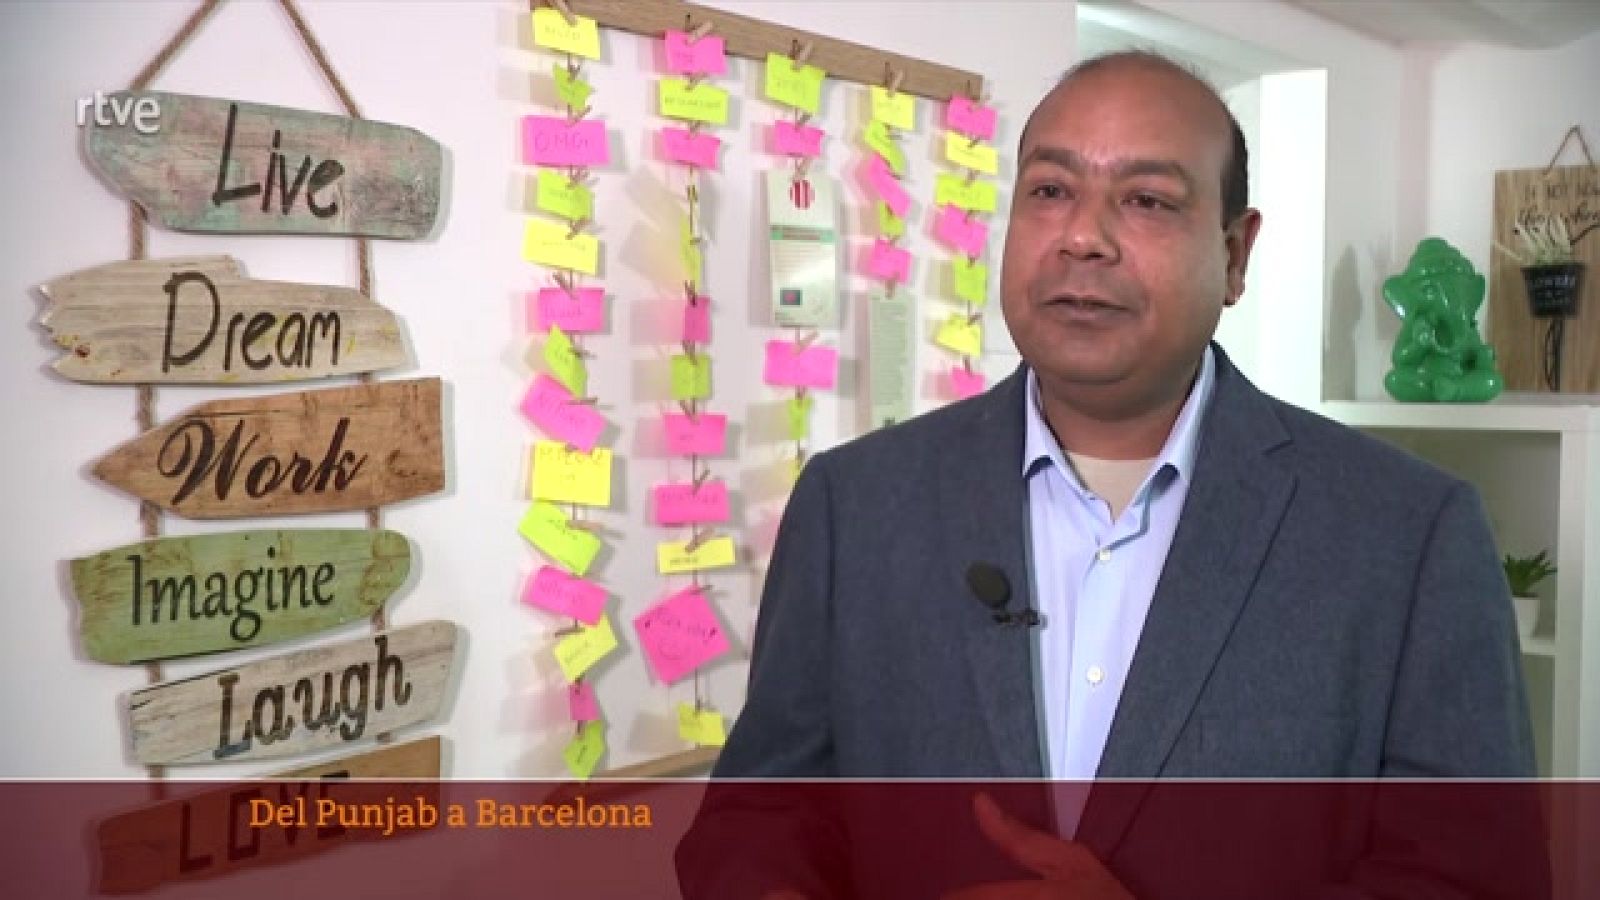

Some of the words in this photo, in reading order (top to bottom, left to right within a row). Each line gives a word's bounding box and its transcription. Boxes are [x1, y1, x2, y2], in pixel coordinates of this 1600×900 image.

[212, 103, 345, 218] Live
[162, 271, 341, 373] Dream
[156, 417, 368, 506] Work
[126, 546, 335, 642] Imagine
[213, 635, 413, 759] Laugh
[179, 770, 349, 873] LOVE
